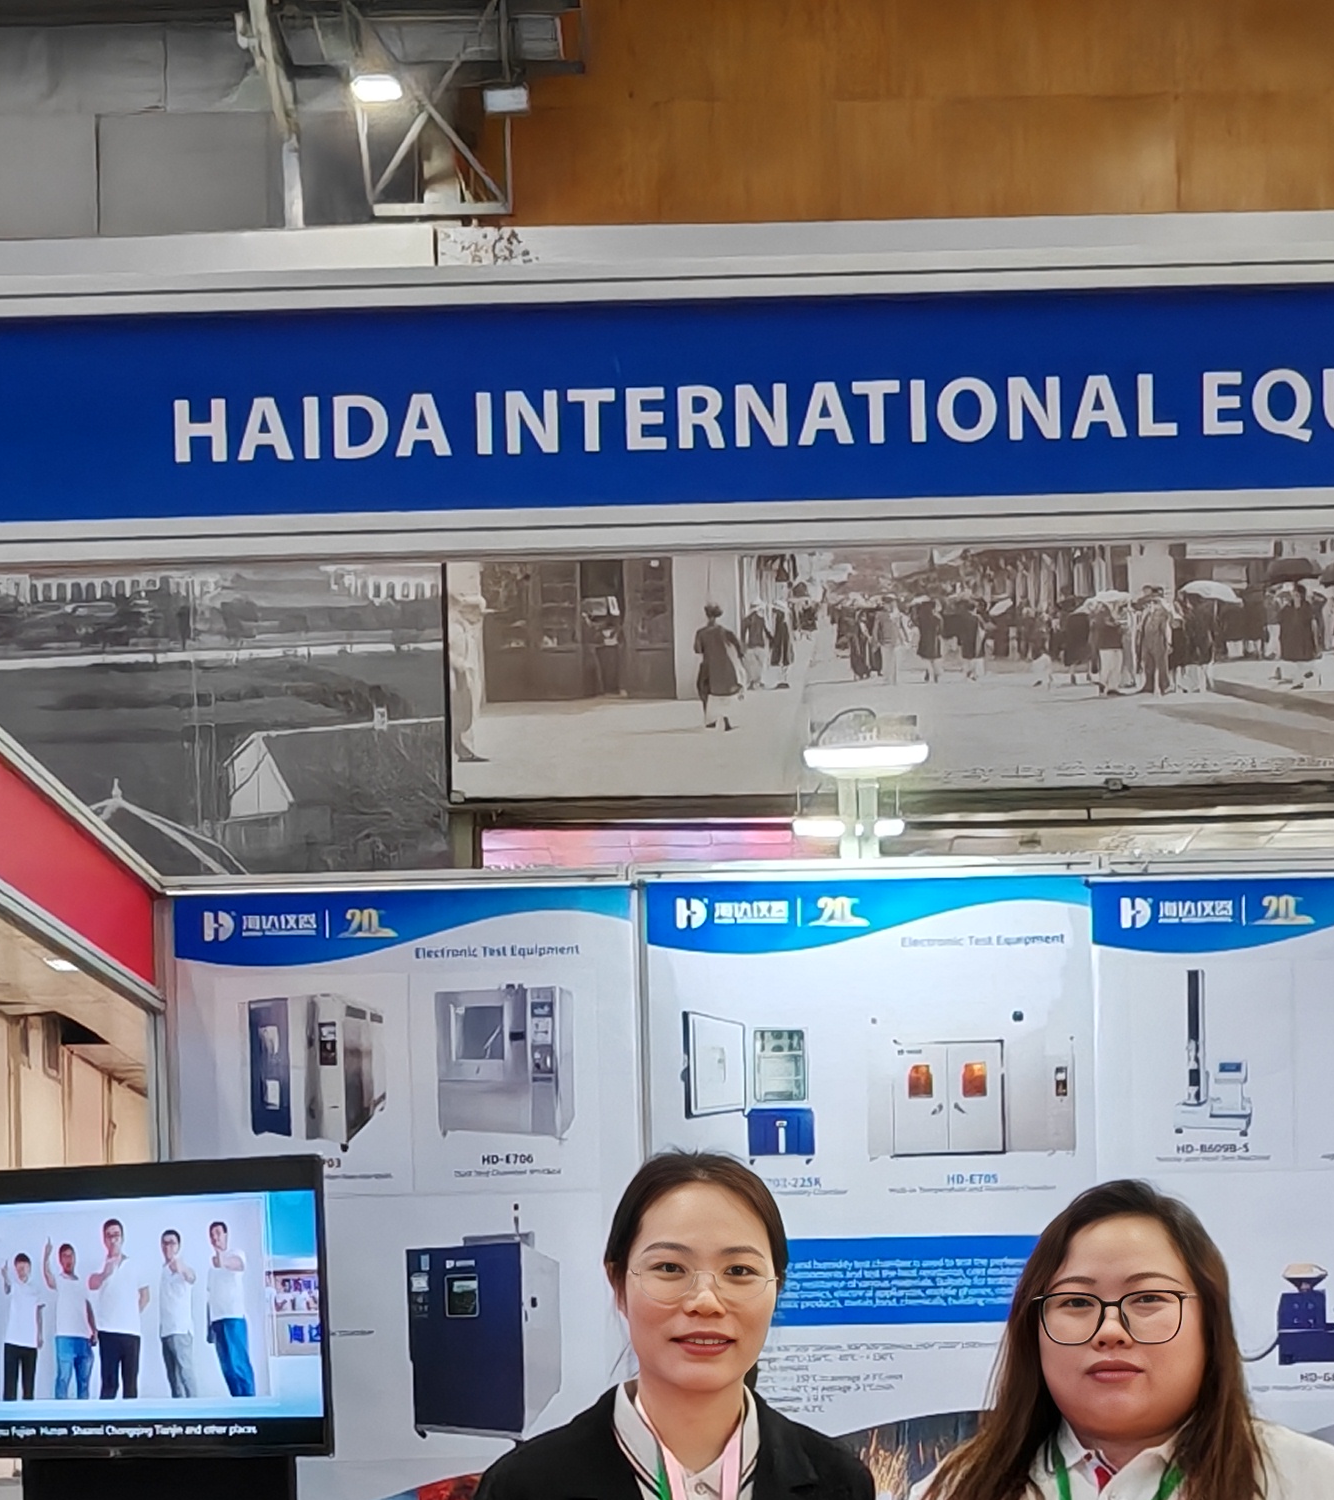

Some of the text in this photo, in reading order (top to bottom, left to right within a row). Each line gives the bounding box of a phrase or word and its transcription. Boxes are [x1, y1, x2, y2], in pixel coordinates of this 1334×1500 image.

[172, 393, 452, 464] HAIDA
[476, 371, 1177, 458] INTERNATIONAL
[967, 934, 993, 947] Test
[415, 943, 581, 960] Electronic Test Equipment
